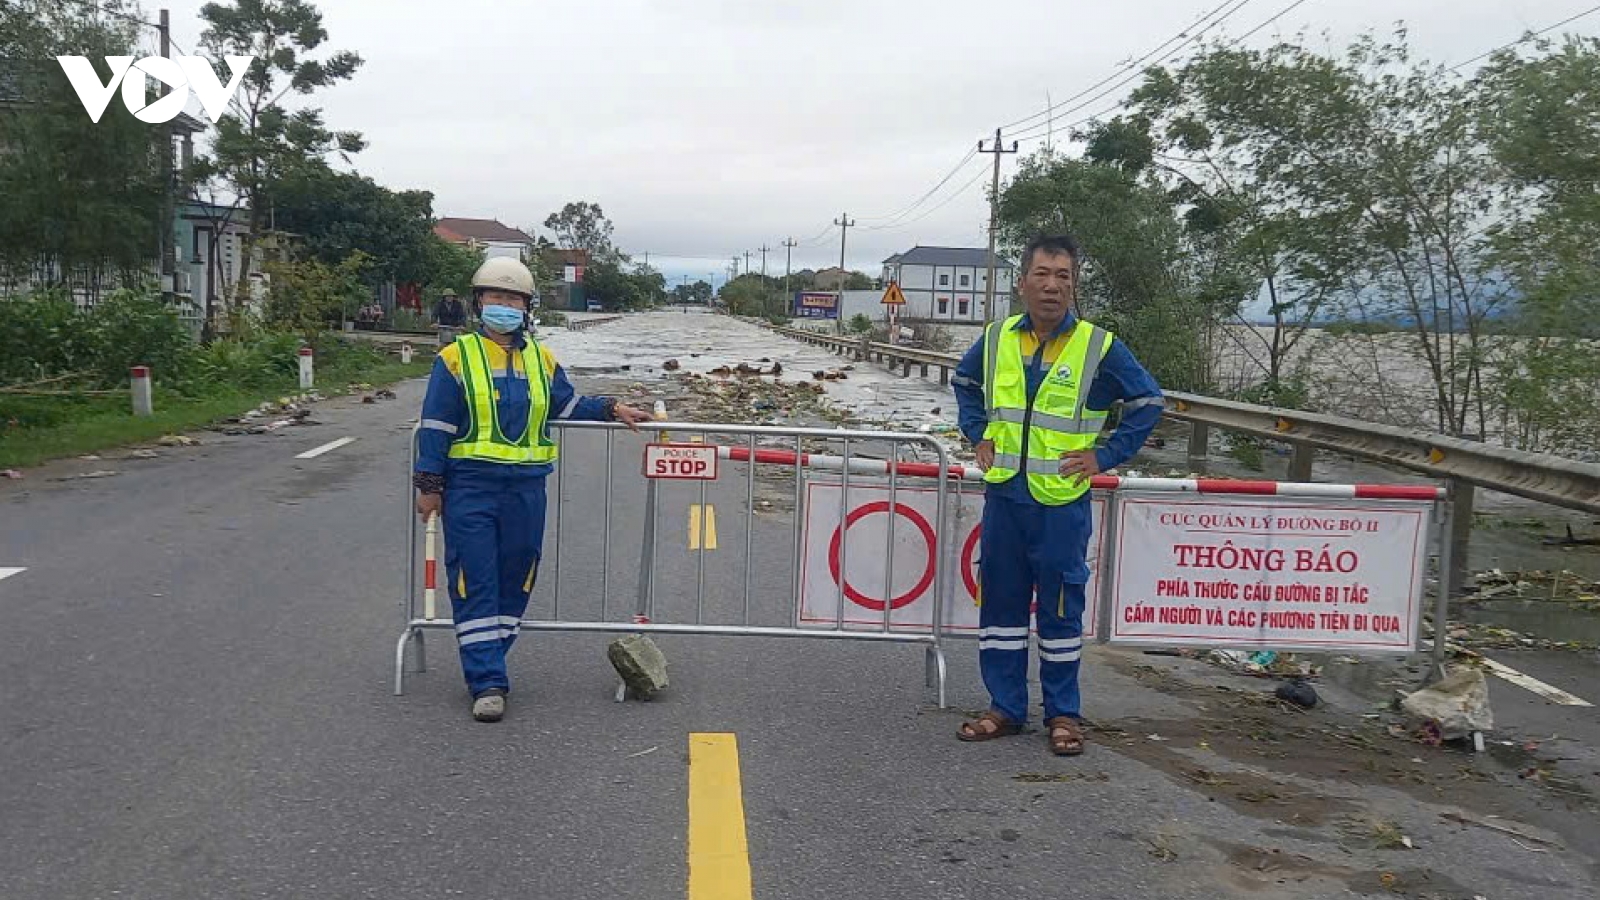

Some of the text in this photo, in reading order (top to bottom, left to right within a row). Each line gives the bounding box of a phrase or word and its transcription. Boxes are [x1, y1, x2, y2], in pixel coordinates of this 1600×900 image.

[663, 449, 699, 458] POLICE
[655, 459, 707, 474] STOP
[1199, 512, 1246, 528] QUẢN
[1251, 514, 1273, 529] LÝ
[1277, 515, 1335, 531] ĐƯỜNG
[1339, 517, 1362, 533] BỘ
[1366, 520, 1379, 532] II
[1173, 540, 1358, 573] THÔNG BÁO
[1157, 577, 1190, 597] PHÍA
[1275, 582, 1321, 603] ĐƯỜNG
[1325, 586, 1339, 606] BỊ
[1343, 582, 1369, 605] TẮC
[1125, 600, 1400, 634] CẤM NGƯỜI VÀ CÁC PHƯƠNG TIỆN ĐI QUA
